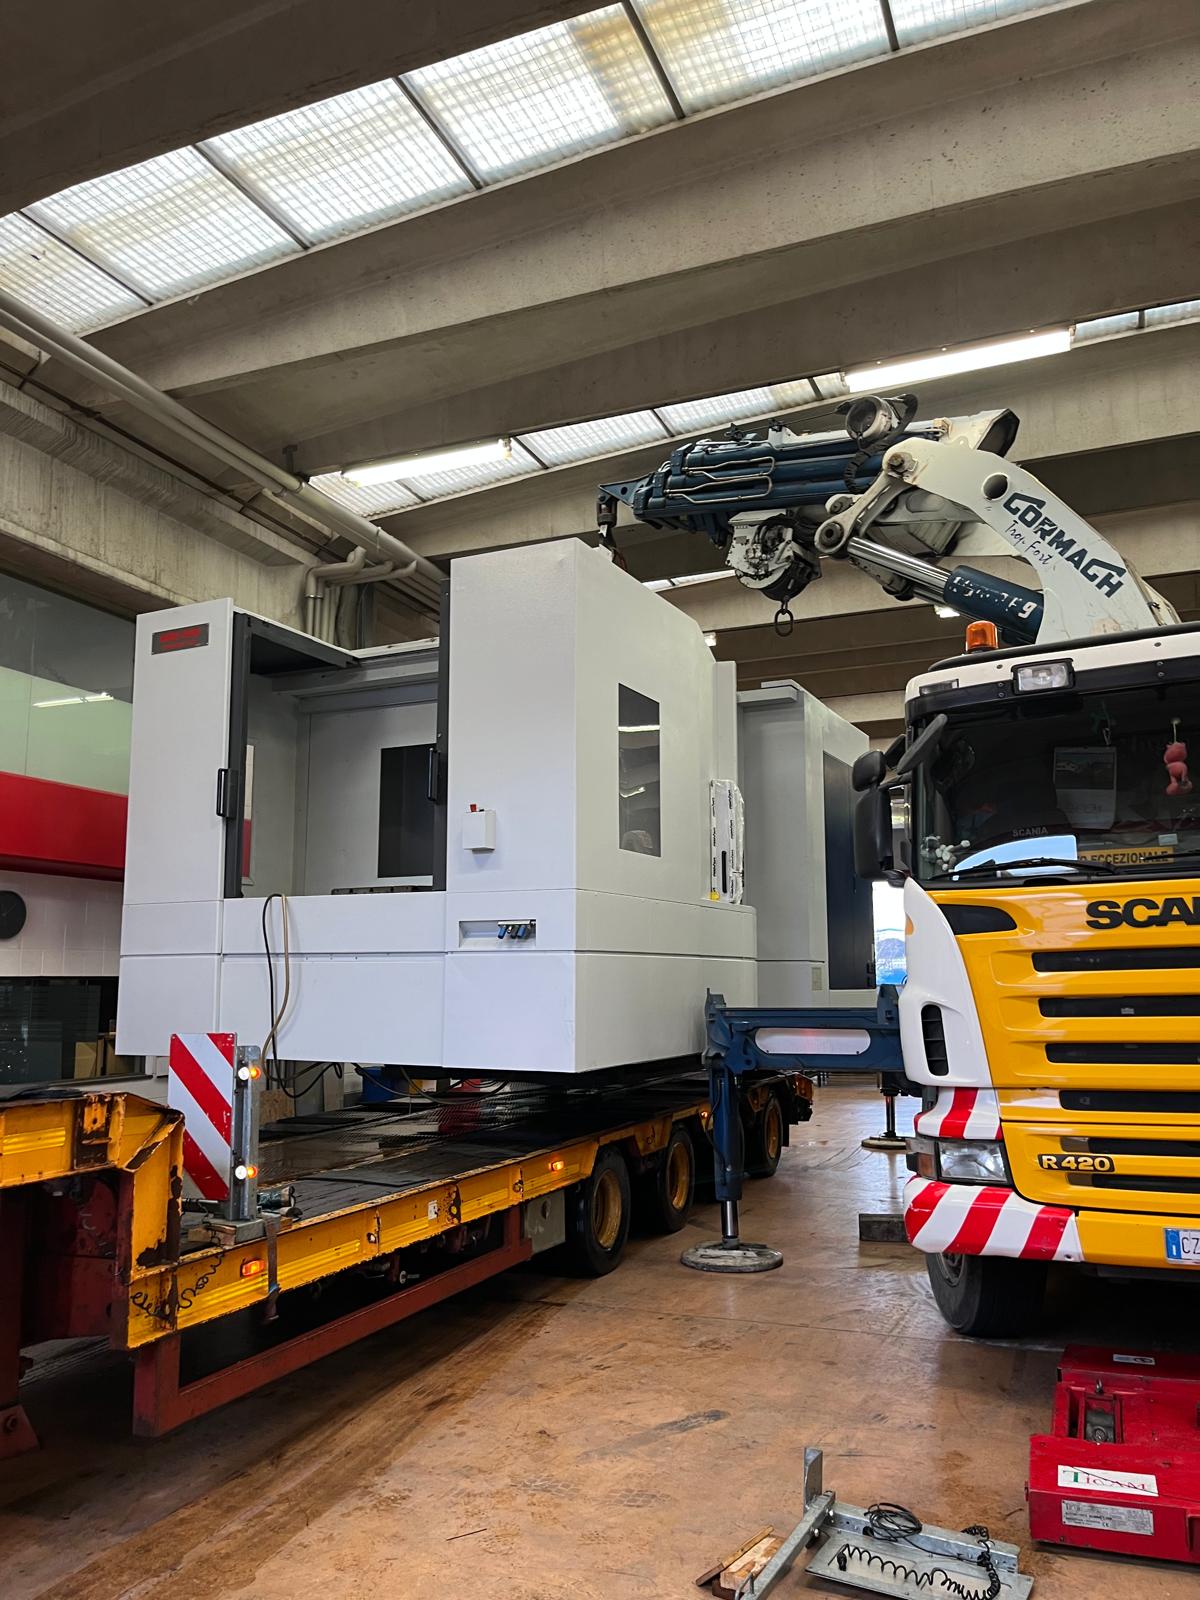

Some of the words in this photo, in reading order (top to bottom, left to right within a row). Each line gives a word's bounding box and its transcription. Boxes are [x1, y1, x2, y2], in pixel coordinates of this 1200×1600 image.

[1012, 826, 1048, 837] SCANIA
[1086, 897, 1200, 929] SCA
[1042, 1156, 1058, 1169] R
[1061, 1156, 1110, 1171] 420
